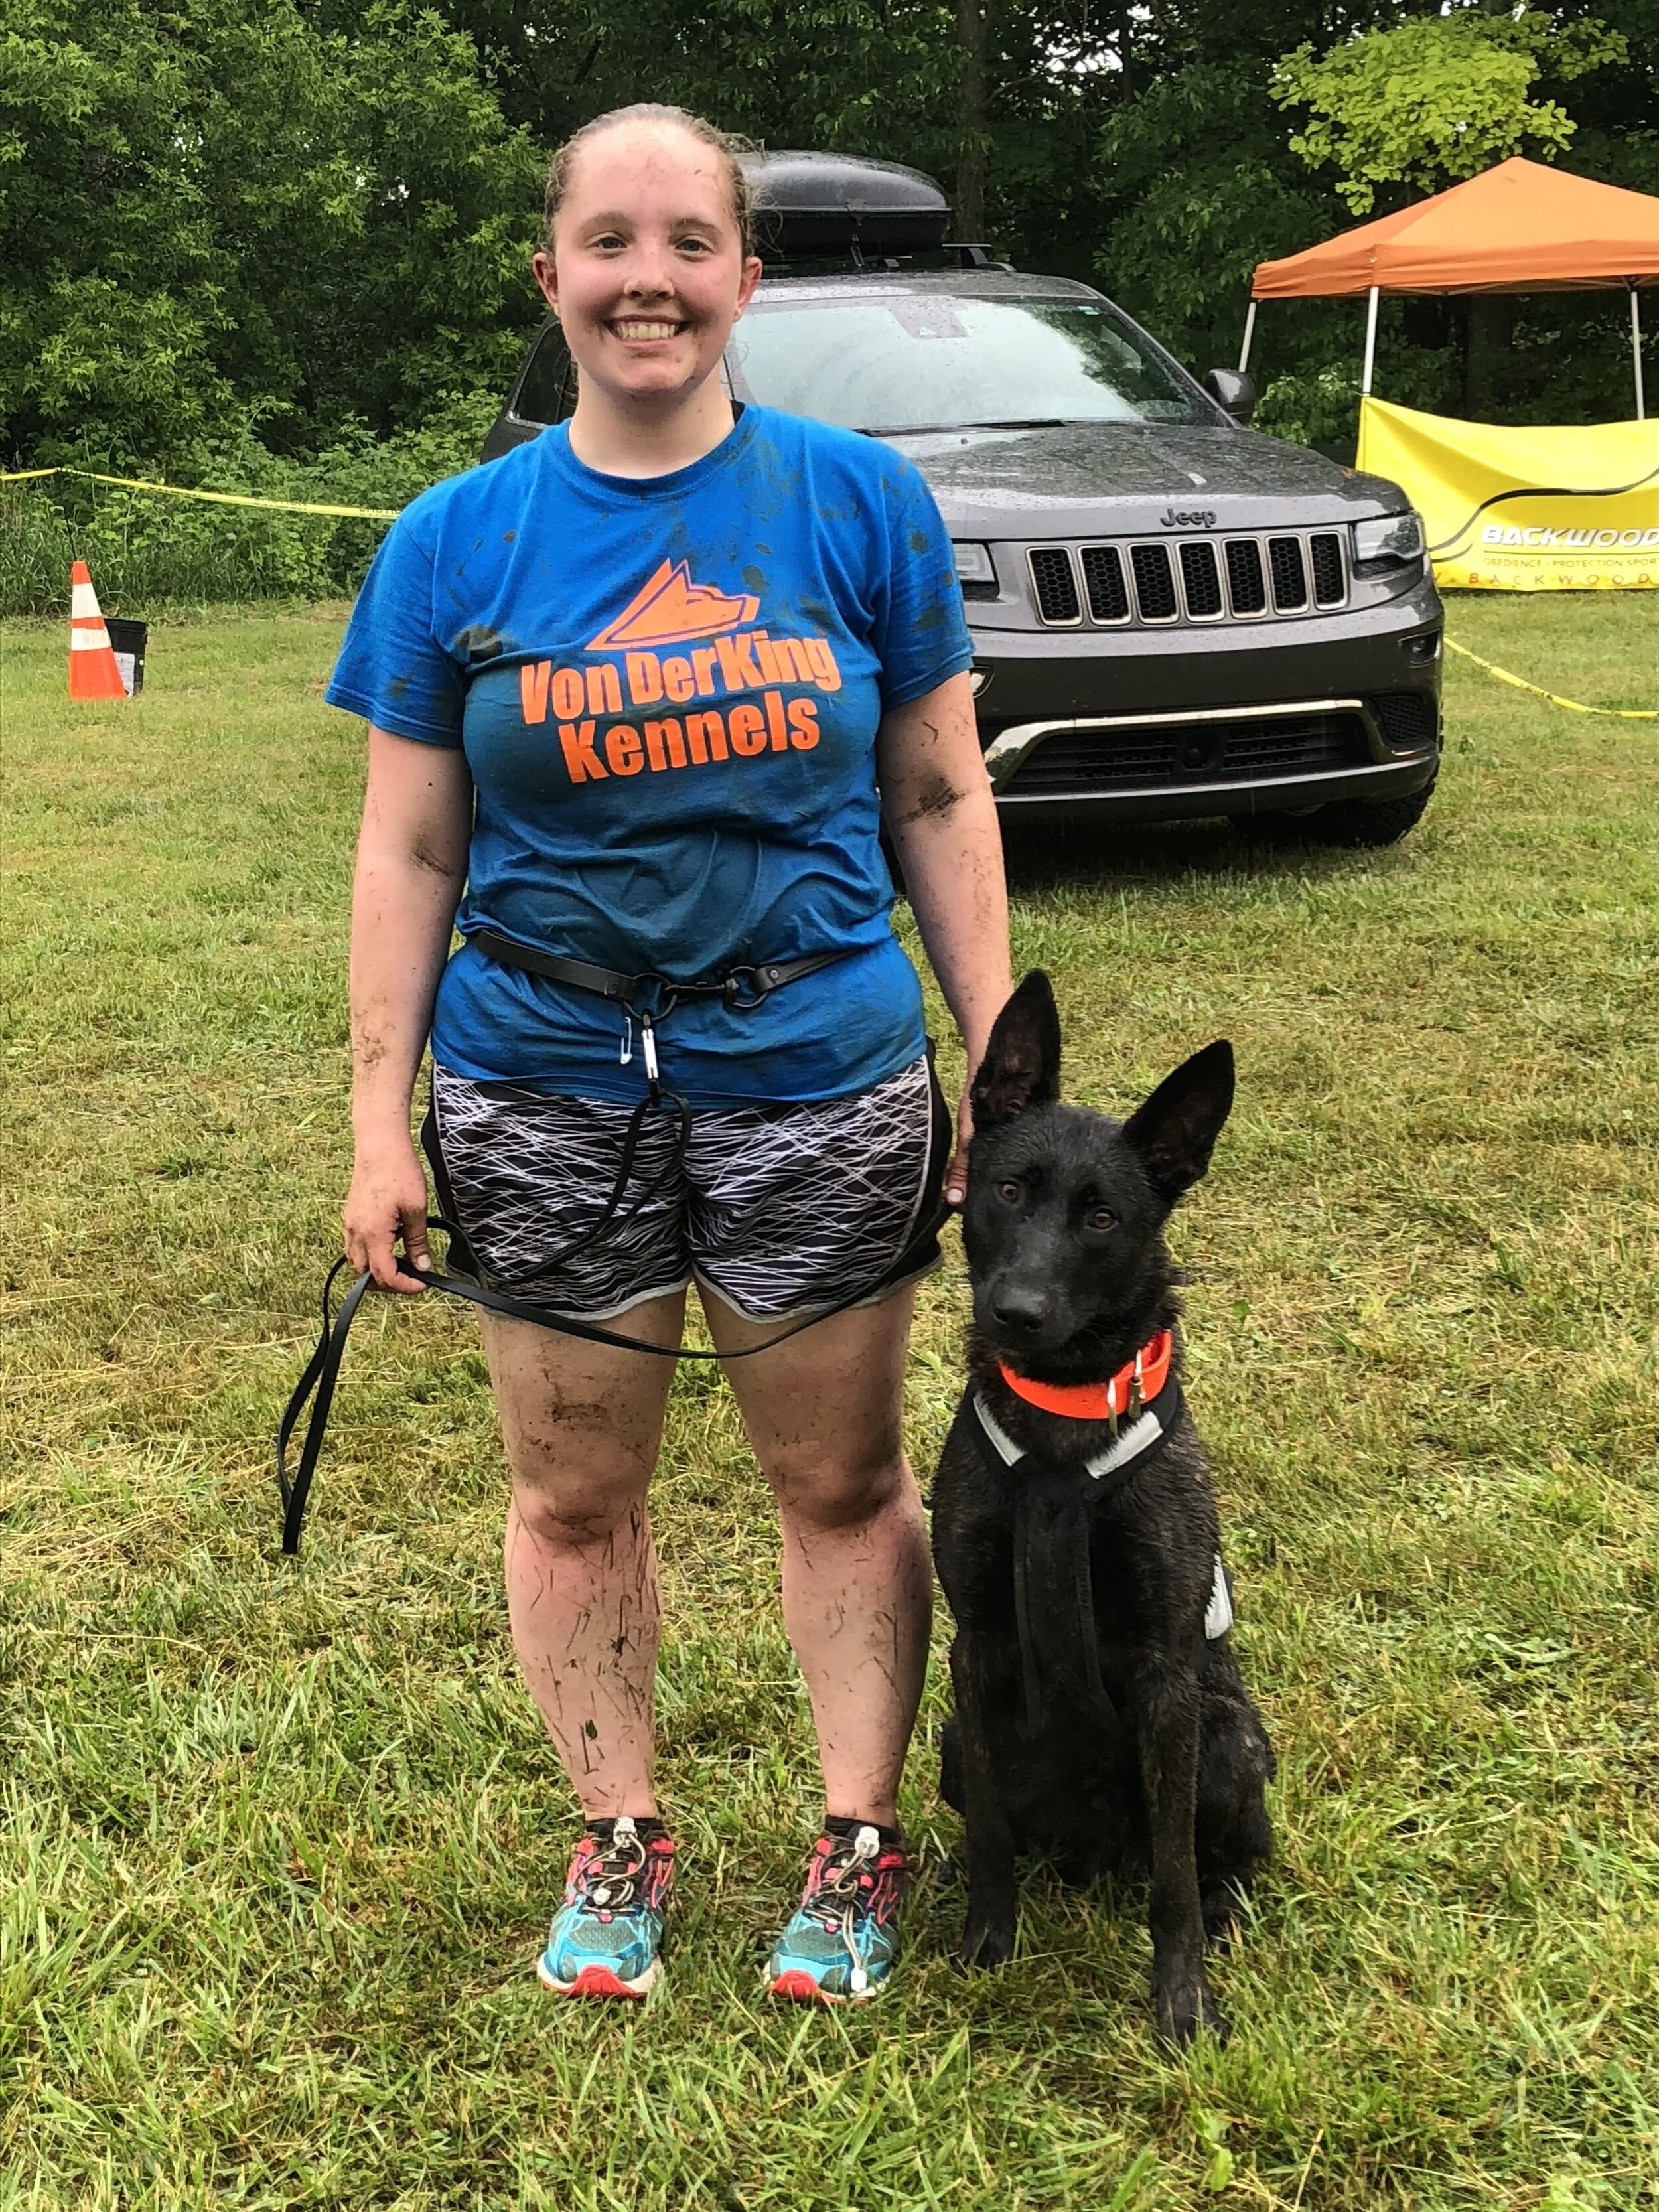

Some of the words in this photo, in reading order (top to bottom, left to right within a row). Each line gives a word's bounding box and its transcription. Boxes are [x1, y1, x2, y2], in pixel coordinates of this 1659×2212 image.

[1160, 508, 1216, 528] Jeep
[1483, 558, 1542, 567] OBEDIENCE
[1552, 559, 1623, 569] PROTECTION
[1627, 558, 1659, 567] SPOR
[520, 660, 623, 725] Von
[626, 630, 842, 705] DerKing
[558, 691, 820, 784] Kennels
